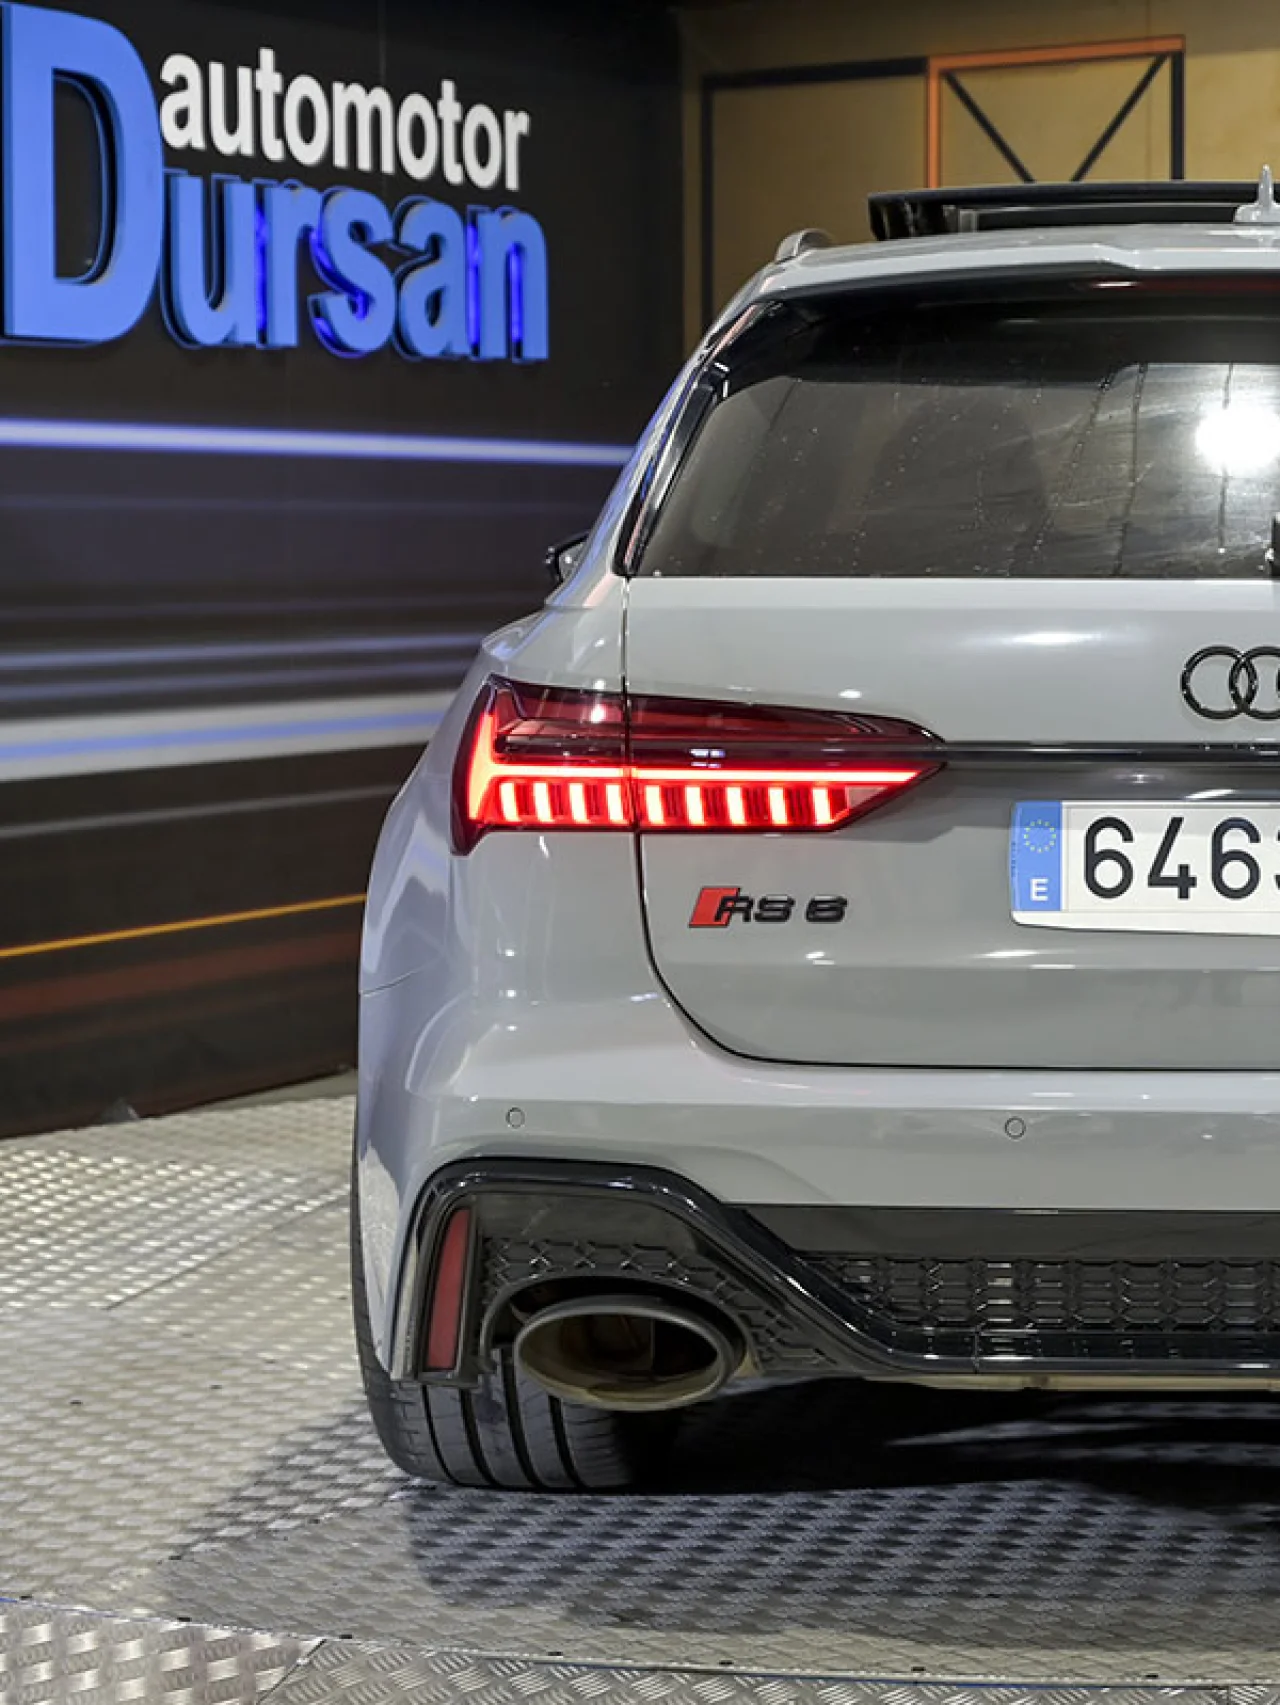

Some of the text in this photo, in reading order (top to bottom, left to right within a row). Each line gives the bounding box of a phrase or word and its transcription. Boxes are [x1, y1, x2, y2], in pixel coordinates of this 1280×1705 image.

[159, 47, 530, 191] automotor
[1, 2, 549, 362] Dursan
[712, 893, 796, 923] RS
[1030, 877, 1049, 901] E
